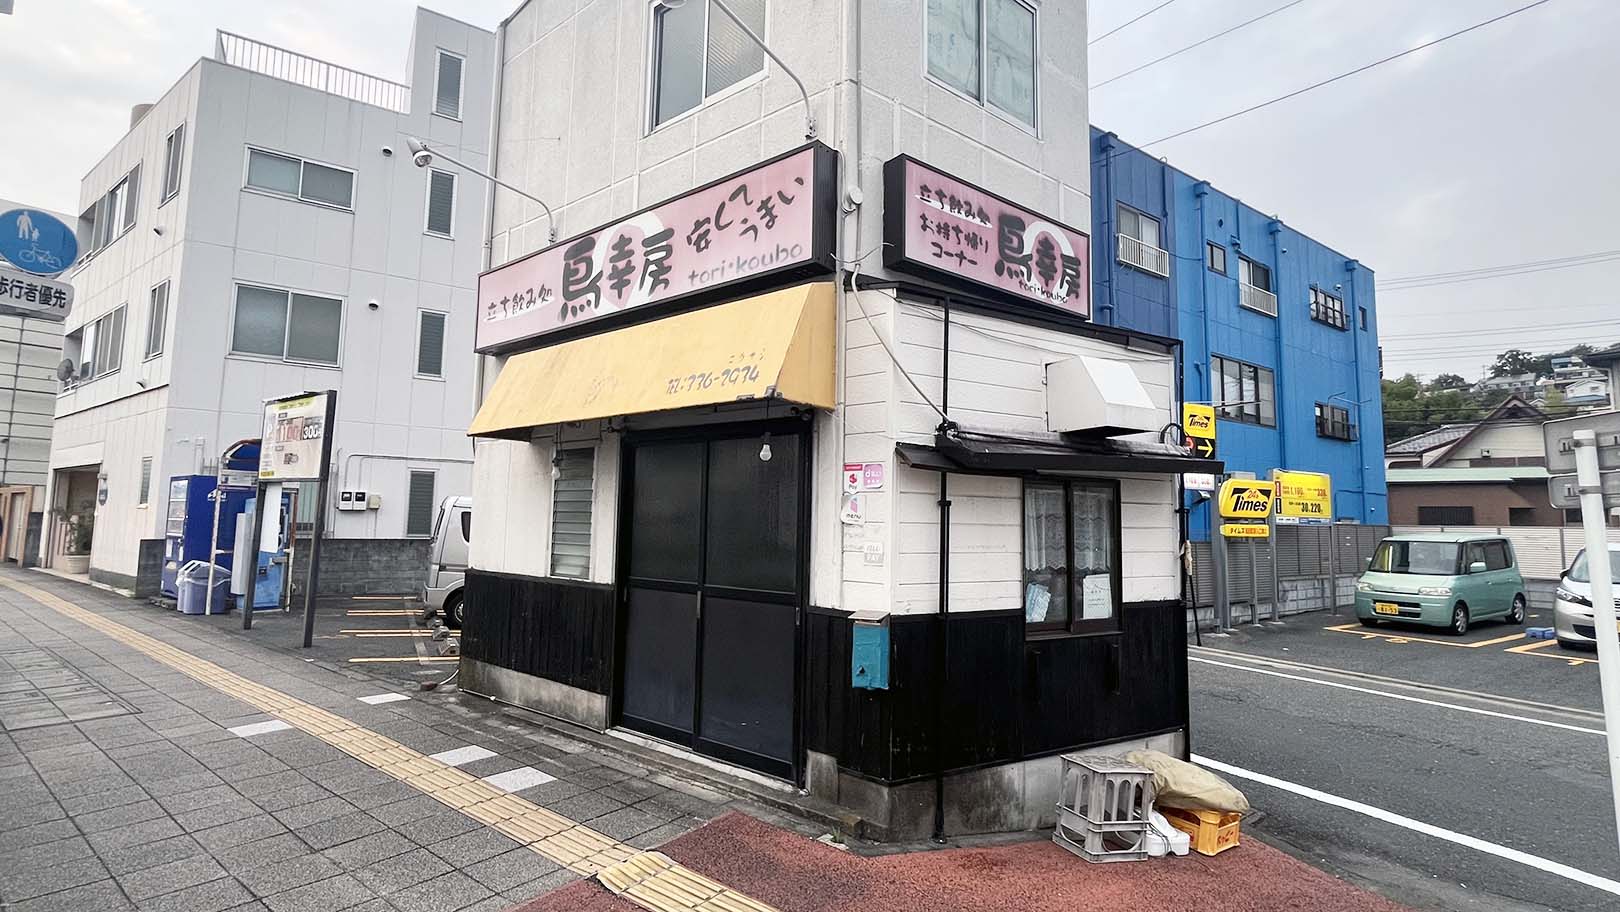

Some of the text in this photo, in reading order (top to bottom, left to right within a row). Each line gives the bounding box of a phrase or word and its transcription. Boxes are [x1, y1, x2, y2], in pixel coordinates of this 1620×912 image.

[686, 183, 754, 253] 安して
[739, 176, 804, 242] うまい
[920, 213, 989, 254] お持ち帰り
[930, 241, 978, 268] コーナー
[558, 228, 675, 322] 鳥幸房
[487, 284, 553, 321] 立ち飲み処
[1189, 415, 1210, 428] Times
[1232, 491, 1269, 512] Times
